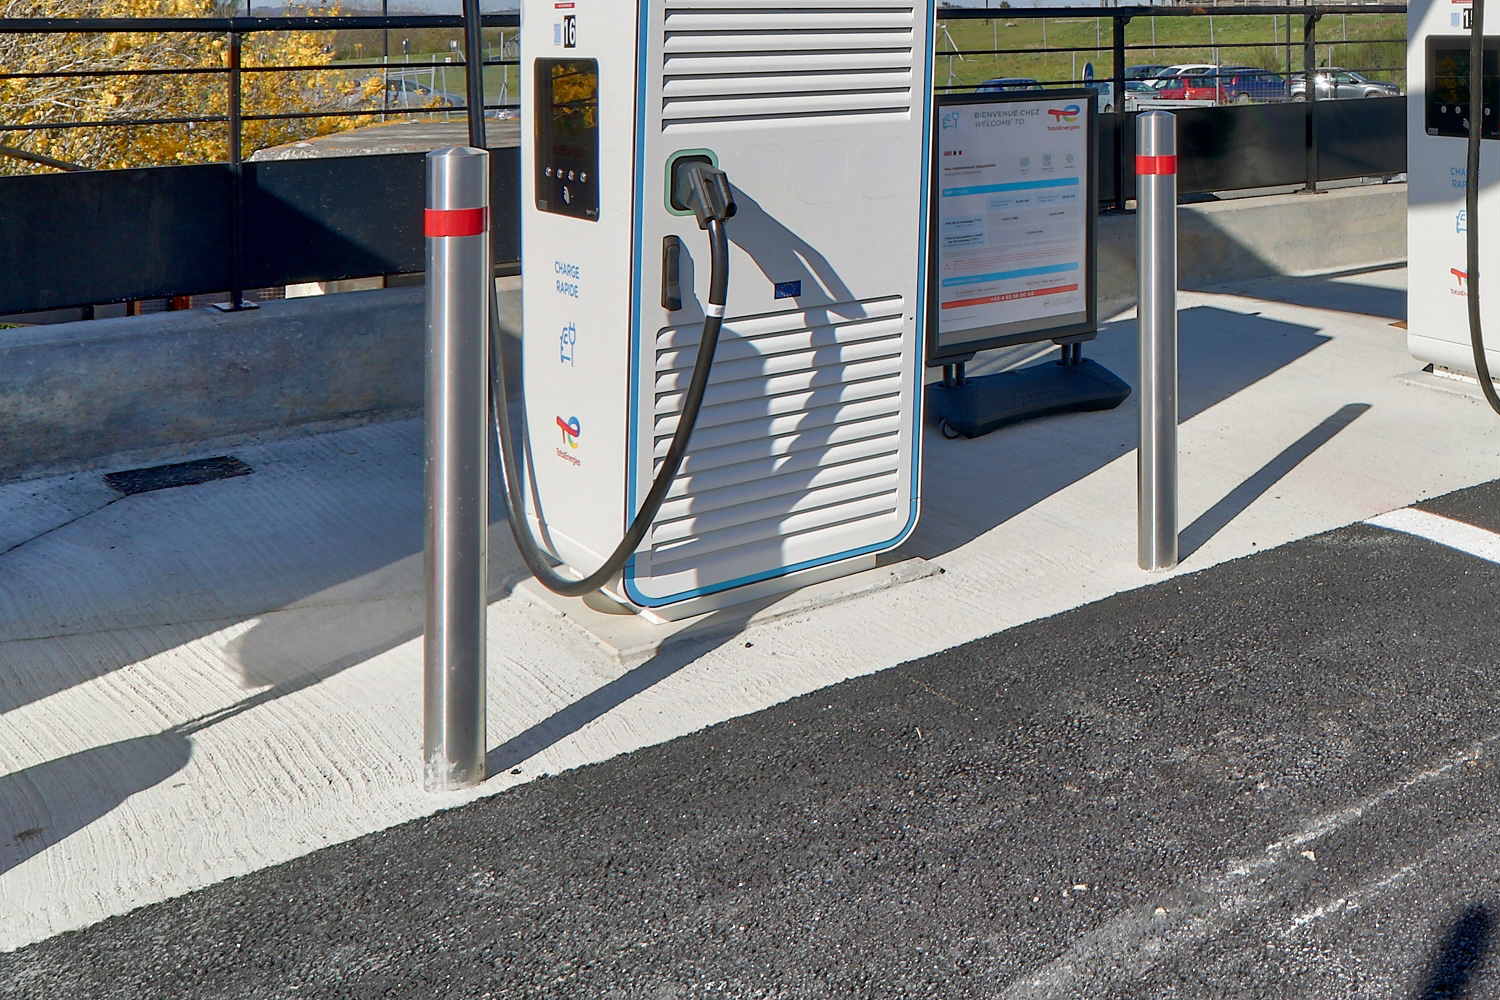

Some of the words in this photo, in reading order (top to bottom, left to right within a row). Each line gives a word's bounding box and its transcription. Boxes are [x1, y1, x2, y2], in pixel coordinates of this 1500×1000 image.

[564, 17, 576, 45] 16
[974, 110, 1018, 119] BIENVENUE
[1020, 108, 1040, 116] CHEZ
[974, 119, 1012, 128] WELCOME
[555, 261, 580, 279] CHARGE
[556, 280, 579, 298] RAPIDE
